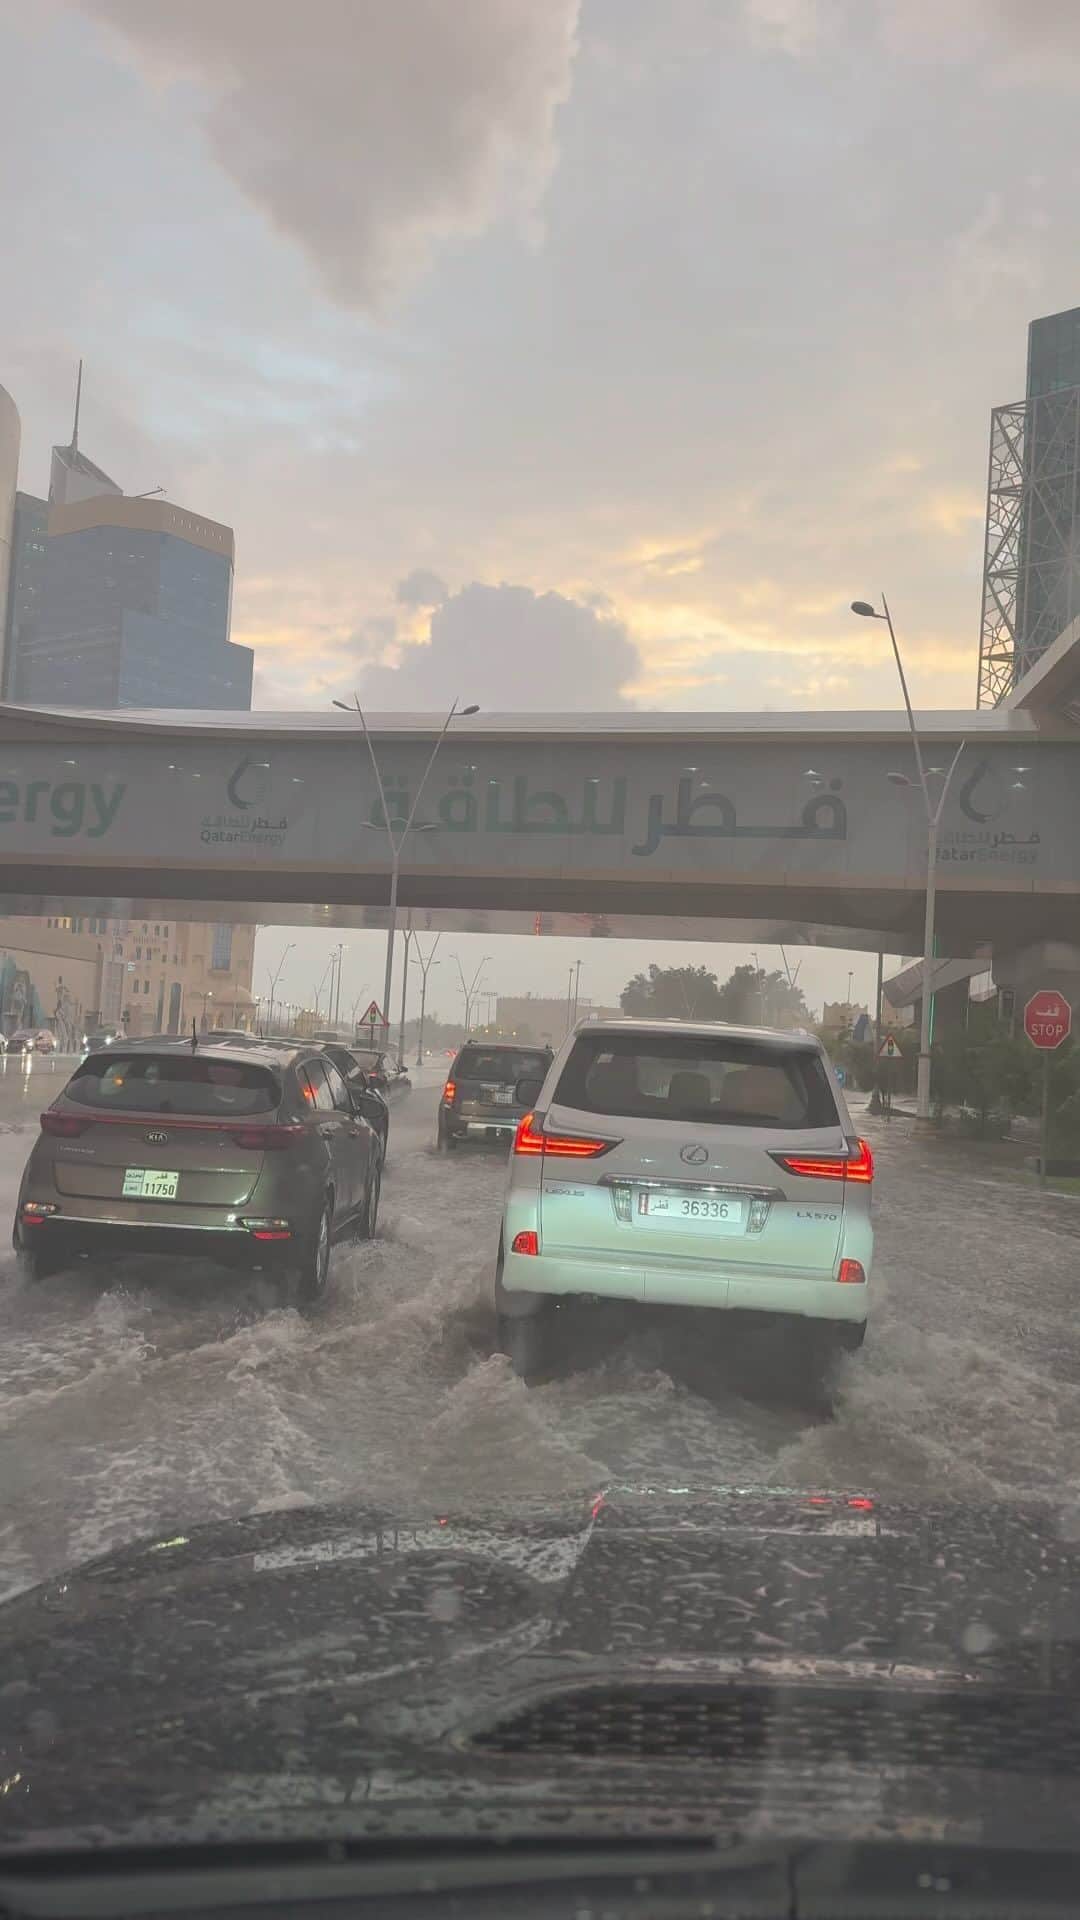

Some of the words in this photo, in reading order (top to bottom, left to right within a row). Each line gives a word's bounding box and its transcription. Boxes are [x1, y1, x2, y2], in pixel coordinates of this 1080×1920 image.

[1031, 1023, 1063, 1036] STOP
[148, 1133, 165, 1142] KIA
[144, 1183, 175, 1196] 11750
[681, 1200, 729, 1218] 36336
